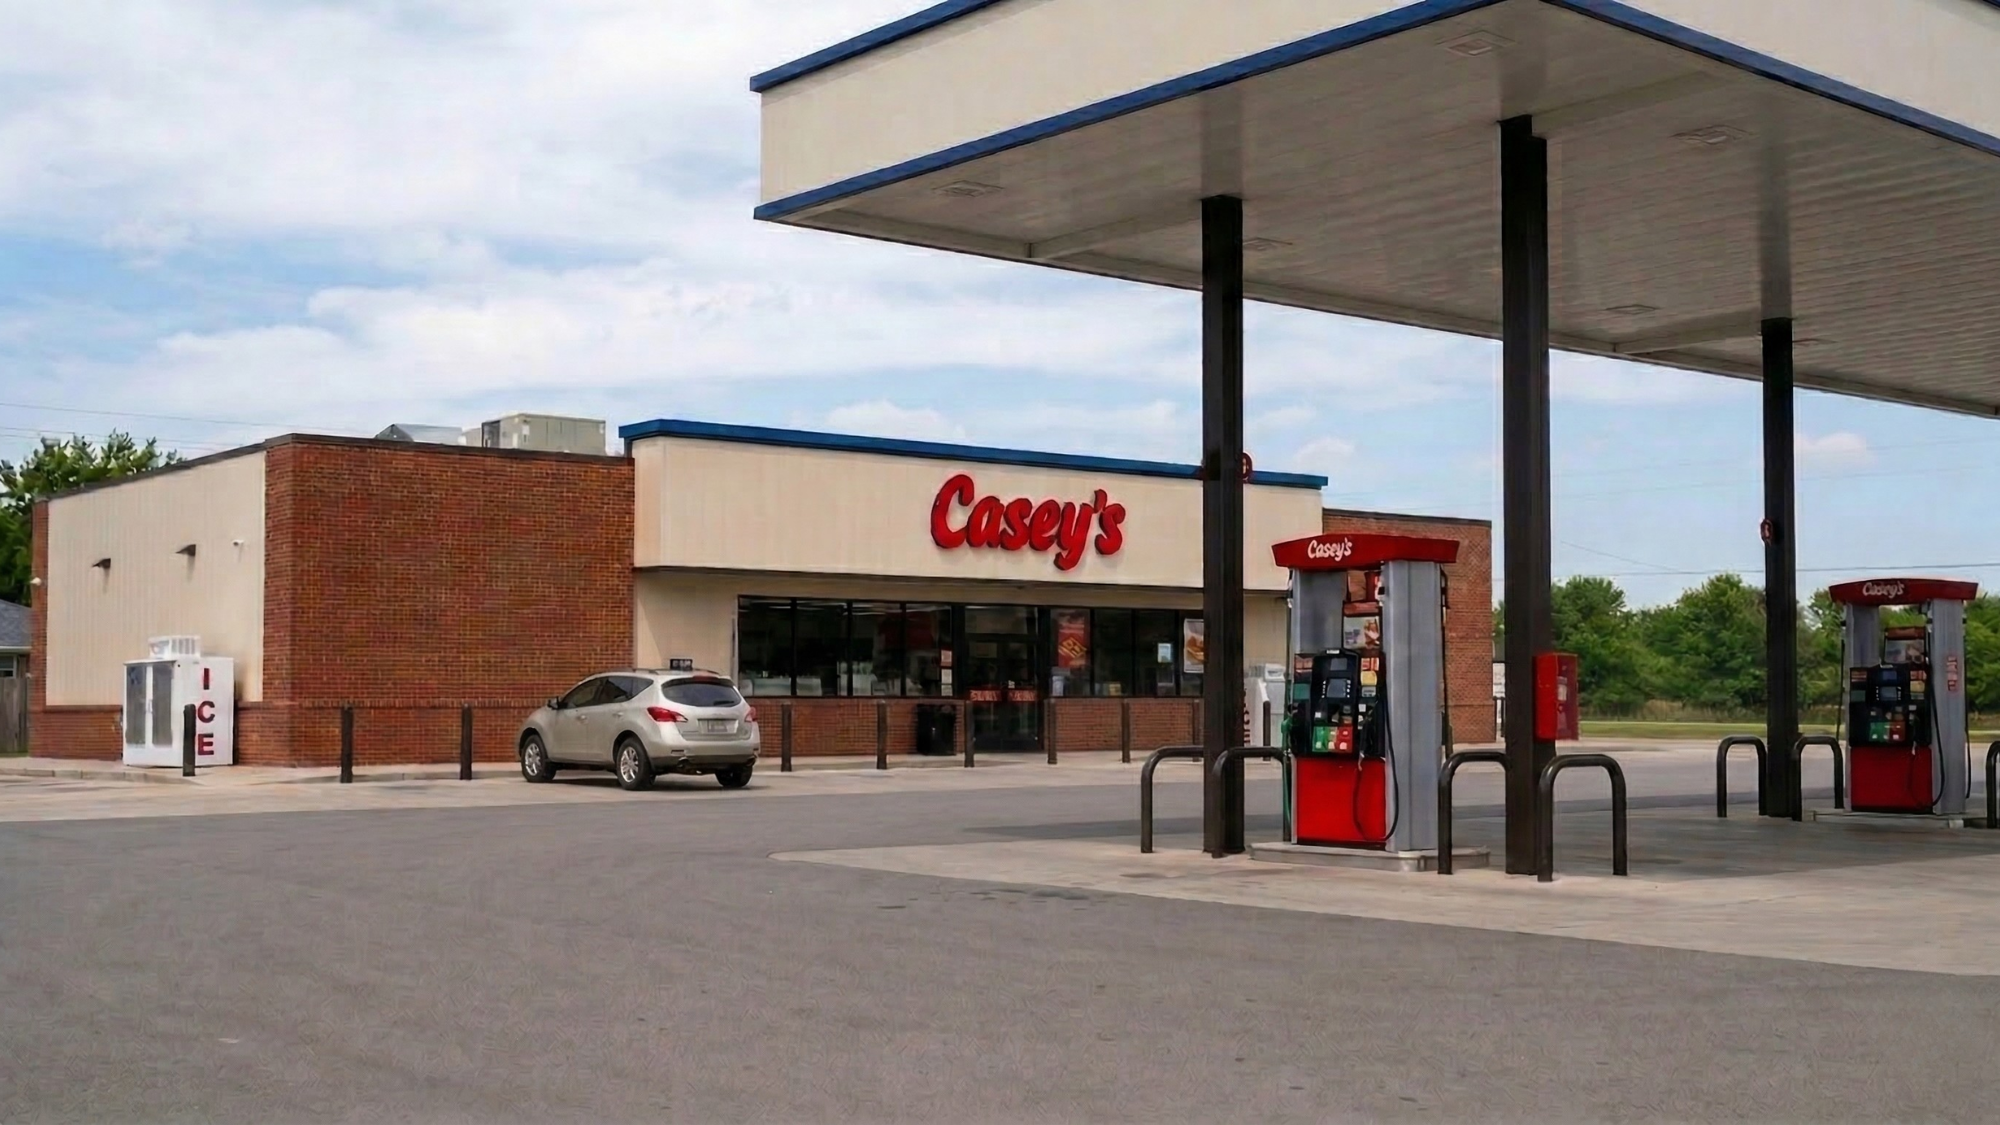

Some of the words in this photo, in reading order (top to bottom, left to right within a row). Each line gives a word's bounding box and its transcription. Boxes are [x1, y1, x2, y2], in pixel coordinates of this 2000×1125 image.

[931, 474, 1126, 570] Casey's
[1307, 537, 1353, 562] Casey's
[197, 668, 216, 756] ICE
